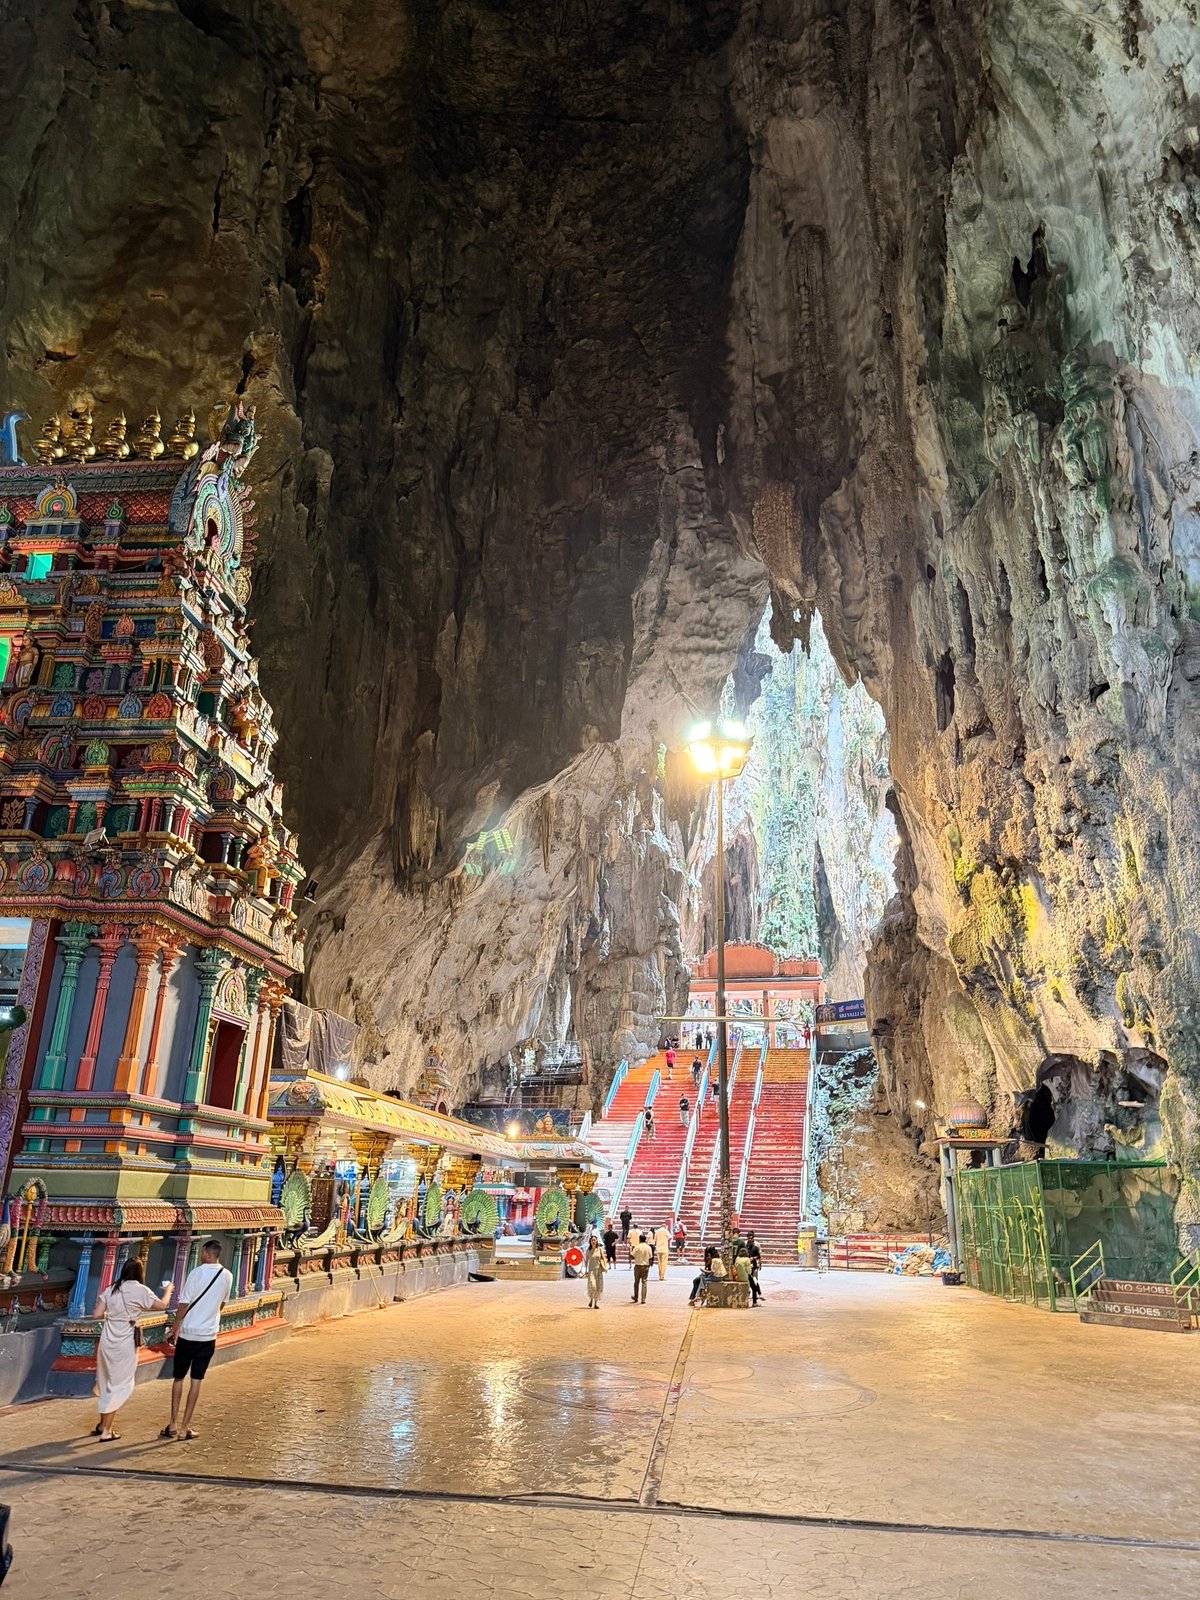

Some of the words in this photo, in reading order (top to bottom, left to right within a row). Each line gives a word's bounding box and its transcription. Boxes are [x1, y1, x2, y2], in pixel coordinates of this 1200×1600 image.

[1116, 1283, 1133, 1292] NO
[1136, 1284, 1173, 1294] SHOES
[1105, 1304, 1121, 1313] NO
[1124, 1305, 1161, 1316] SHOES
